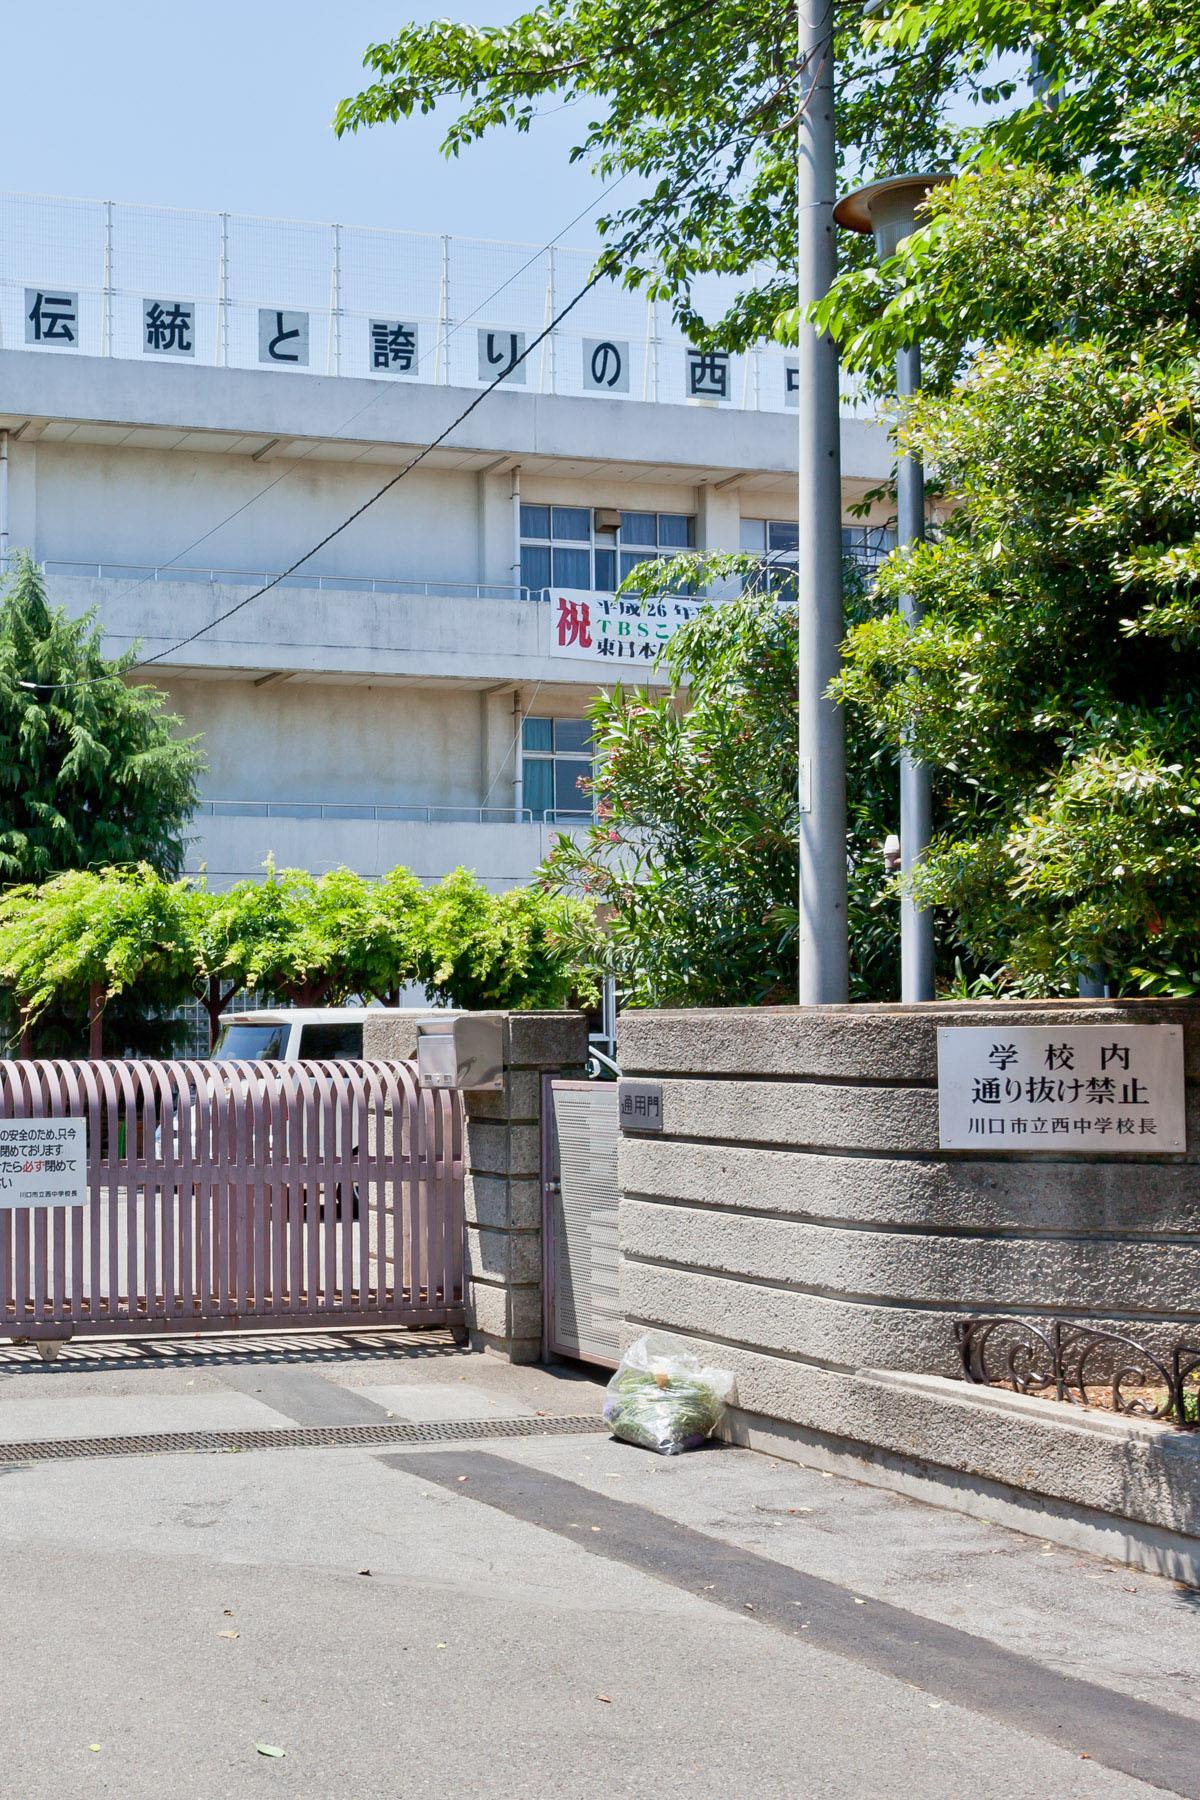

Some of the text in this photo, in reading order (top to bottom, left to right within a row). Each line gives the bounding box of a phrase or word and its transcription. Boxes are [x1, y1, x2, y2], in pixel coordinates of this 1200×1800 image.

[597, 600, 700, 619] 平成26年
[557, 597, 592, 648] 祝
[597, 620, 682, 638] TBSこ
[597, 638, 666, 659] 東日本
[971, 1076, 1150, 1104] 通り抜け禁止
[621, 1095, 659, 1117] 通用門
[968, 1117, 1157, 1135] 川口市立西中学校長
[19, 1190, 78, 1198] 川口市立西中学校長
